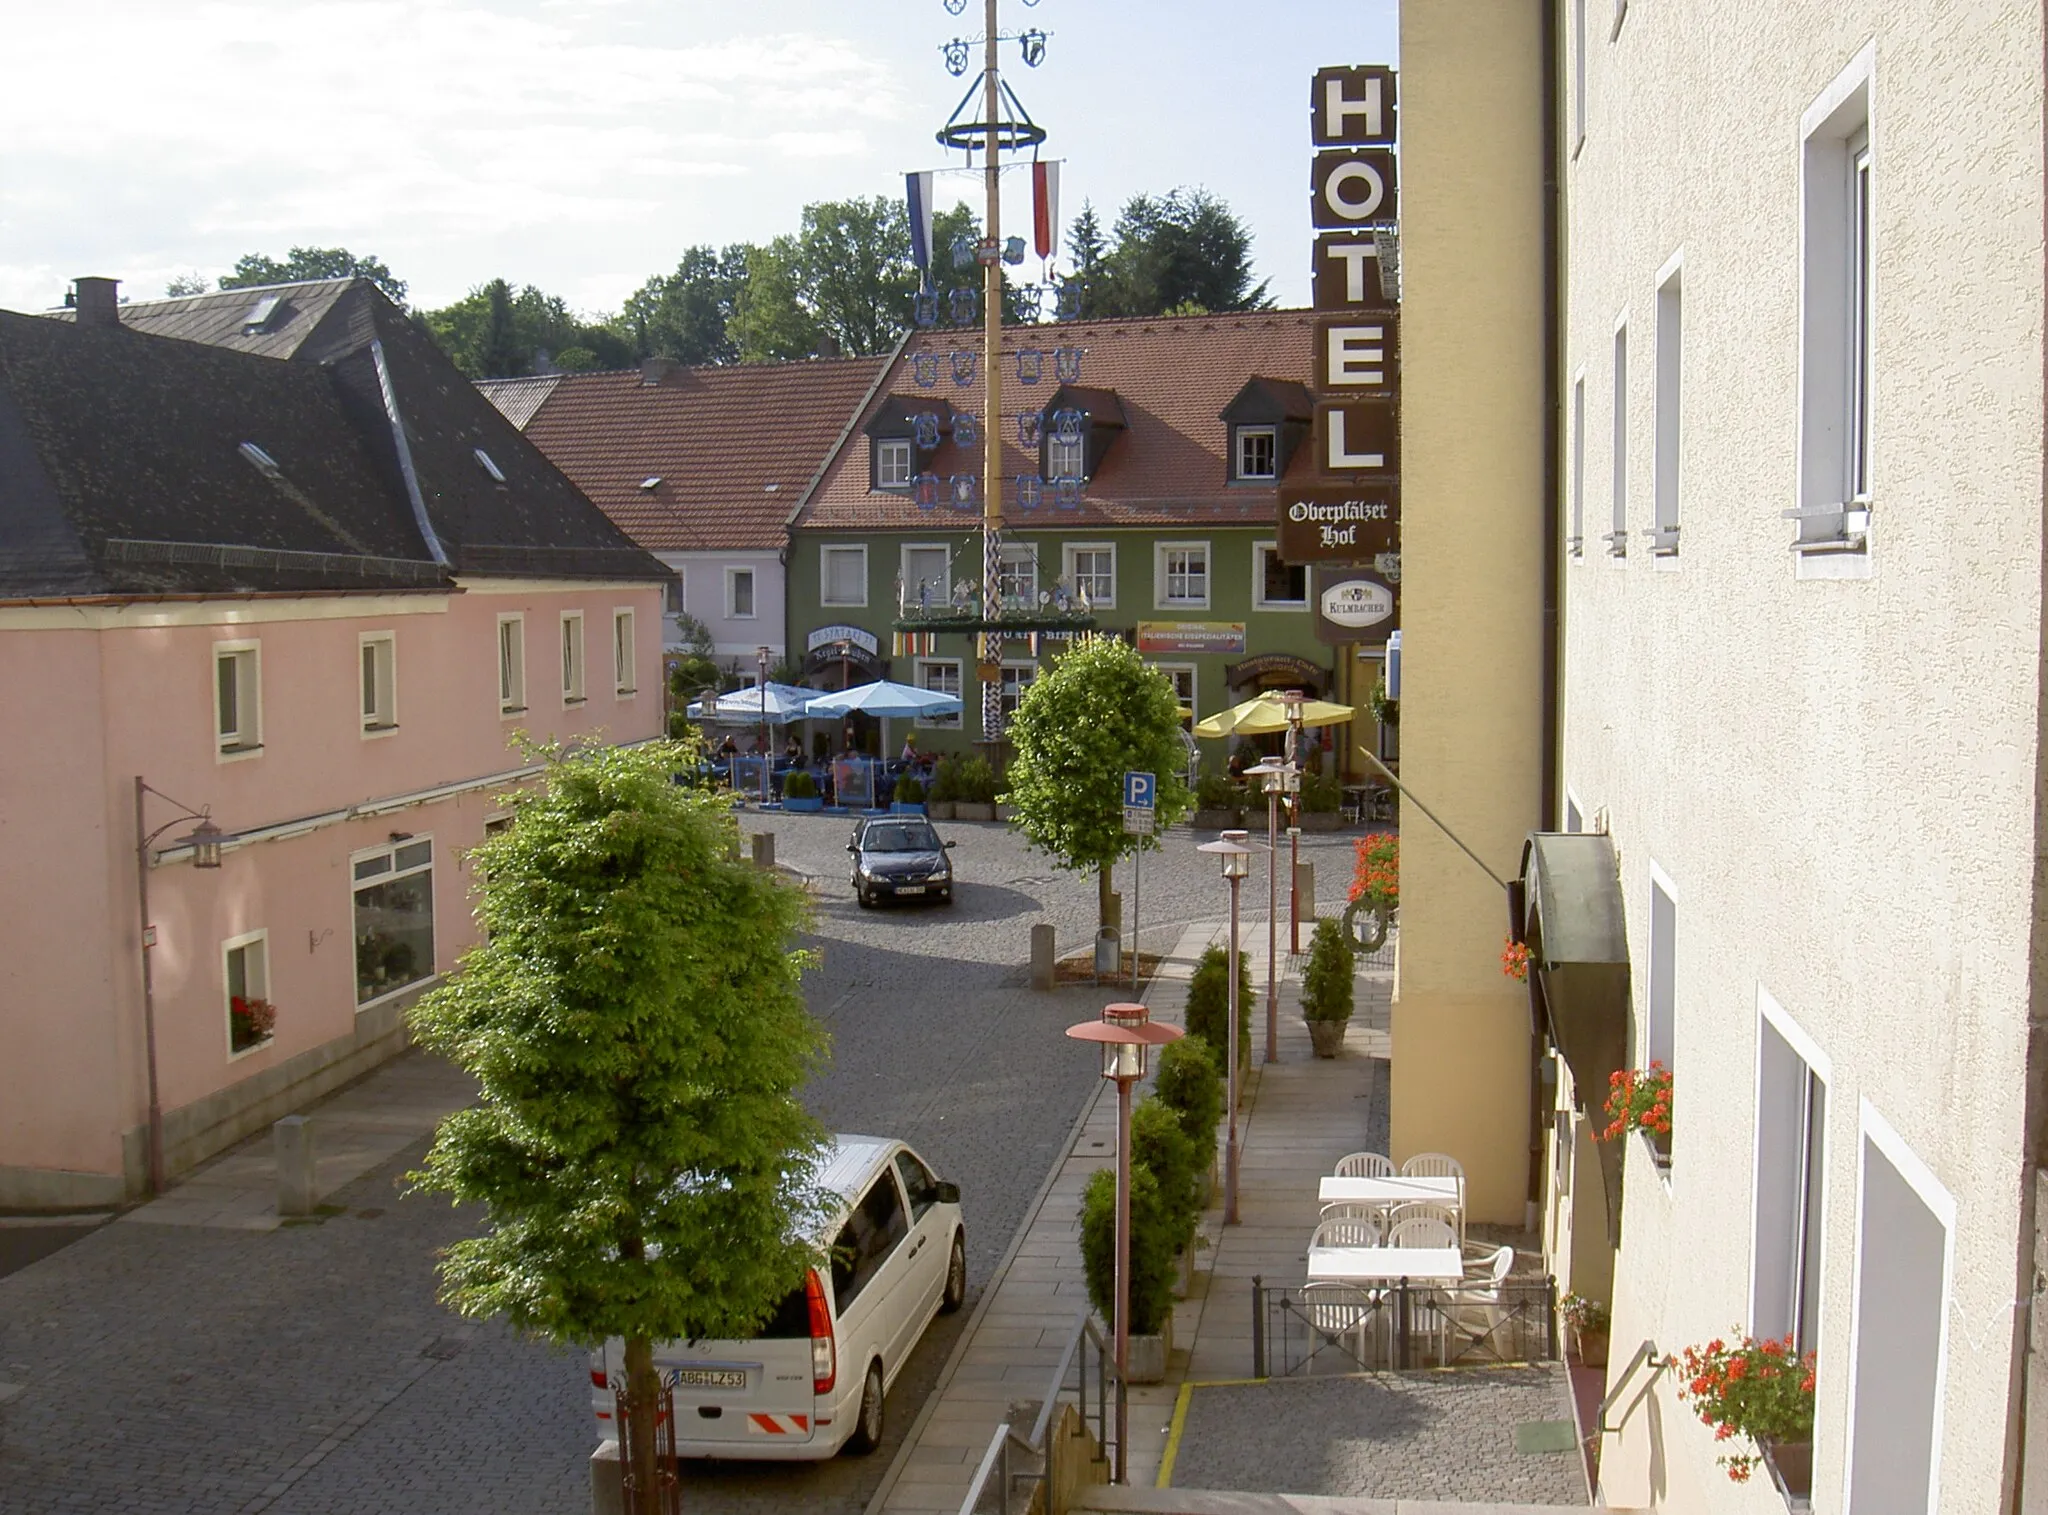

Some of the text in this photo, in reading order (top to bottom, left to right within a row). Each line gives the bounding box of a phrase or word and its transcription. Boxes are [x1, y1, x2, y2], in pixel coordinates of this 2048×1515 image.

[1325, 78, 1384, 470] HOTEL
[1288, 500, 1388, 524] Oberpfälzer
[1319, 525, 1357, 549] Hof
[1329, 601, 1385, 614] KULMBACHER
[1131, 776, 1148, 803] P
[680, 1371, 703, 1385] ABG
